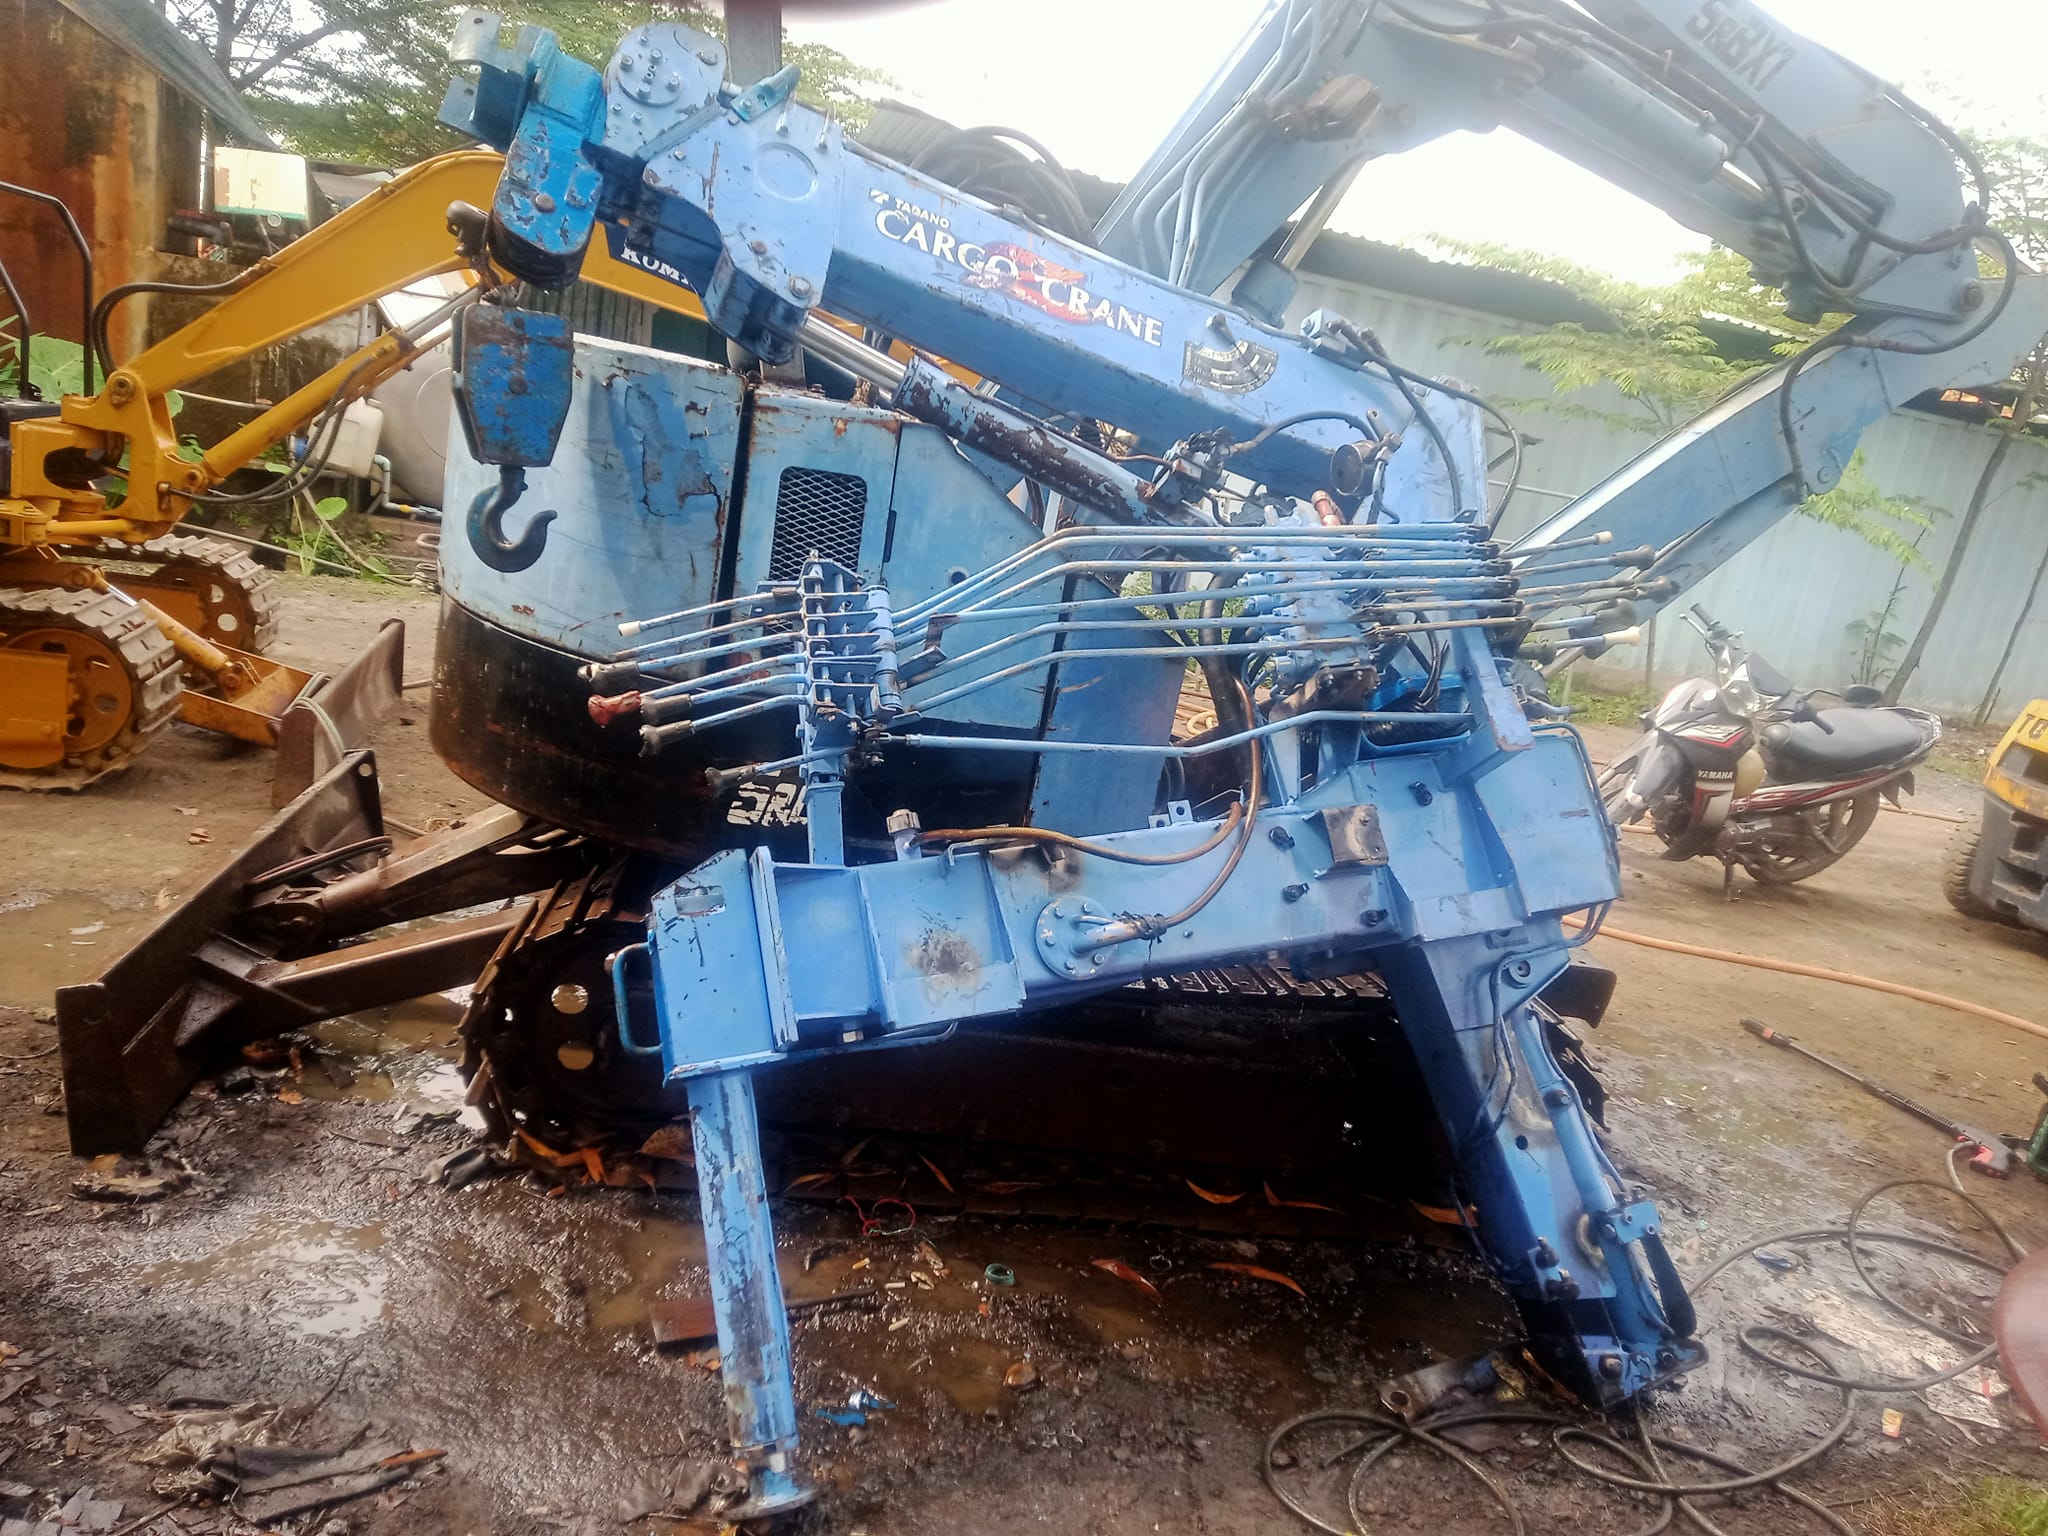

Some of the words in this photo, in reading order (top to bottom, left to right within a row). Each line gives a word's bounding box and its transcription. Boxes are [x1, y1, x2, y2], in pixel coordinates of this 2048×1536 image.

[894, 197, 951, 229] TADANO
[875, 208, 1020, 280] CARGO
[1041, 273, 1164, 347] CRANE
[1697, 769, 1734, 780] YAMAHA
